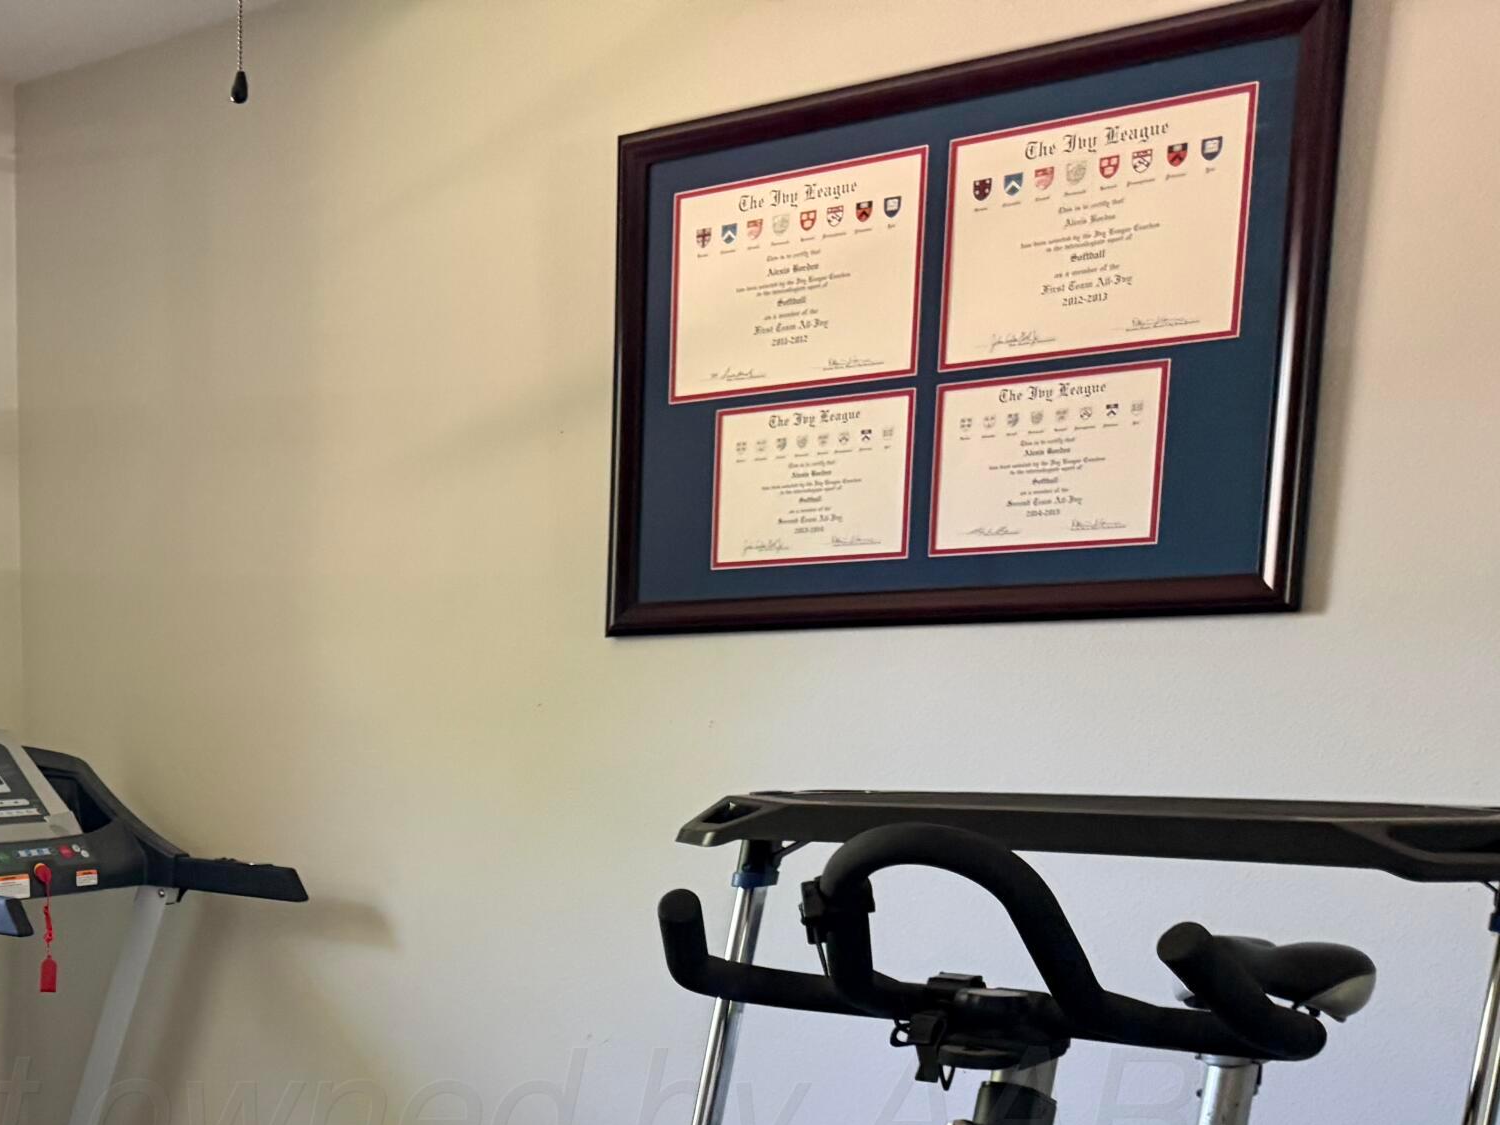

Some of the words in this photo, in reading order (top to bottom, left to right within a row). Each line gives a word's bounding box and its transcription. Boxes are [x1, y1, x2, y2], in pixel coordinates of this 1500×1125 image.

[1025, 140, 1056, 160] The
[1063, 134, 1098, 154] Ivy
[1105, 122, 1170, 145] League
[738, 194, 764, 212] The
[771, 189, 799, 208] Ivy
[805, 182, 858, 201] League
[1070, 250, 1106, 262] Softball
[1062, 293, 1108, 306] 2012-2013
[999, 388, 1022, 404] The
[1028, 386, 1053, 401] Ivy
[1059, 383, 1106, 398] League
[769, 415, 789, 428] The
[793, 413, 815, 427] Ivy
[820, 410, 861, 423] League
